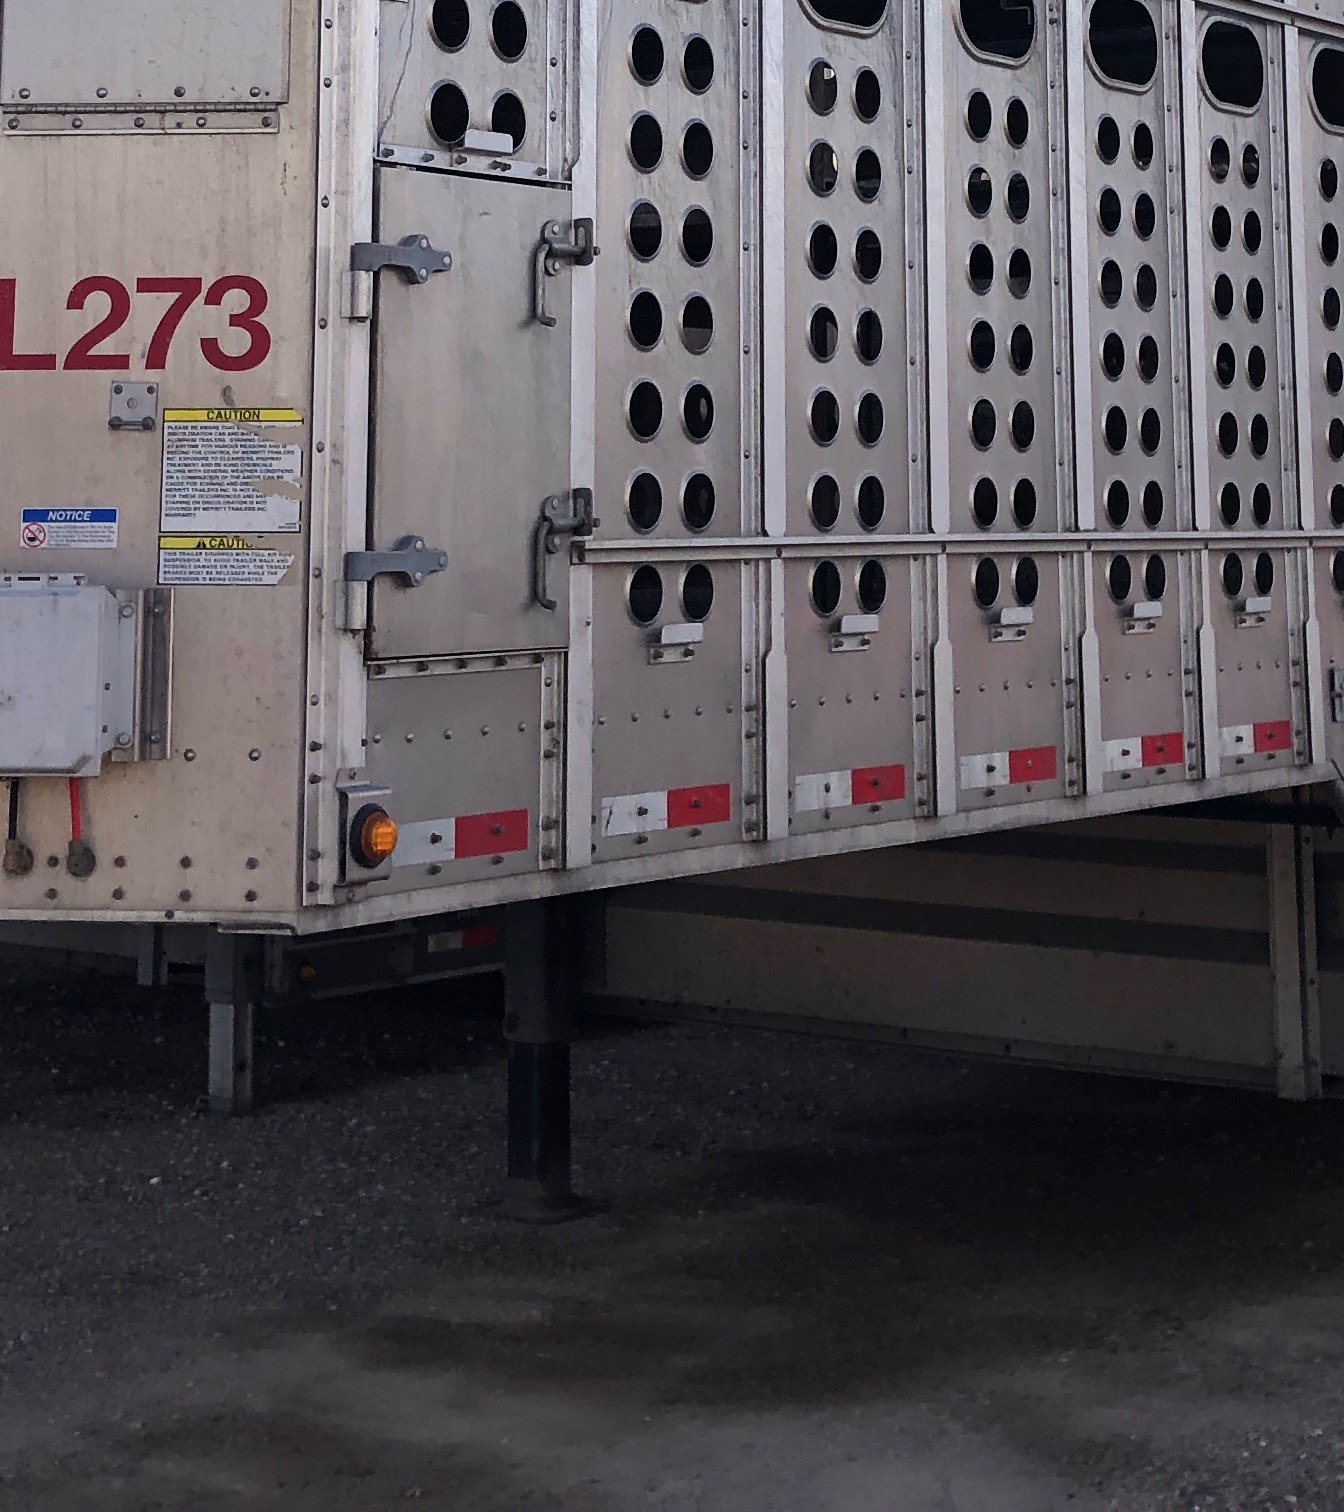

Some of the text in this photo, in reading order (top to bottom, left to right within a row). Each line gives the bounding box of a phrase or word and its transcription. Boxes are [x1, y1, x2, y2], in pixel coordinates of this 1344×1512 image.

[207, 410, 260, 420] CAUTION
[47, 510, 92, 521] NOTICE
[209, 538, 253, 548] CAUTI
